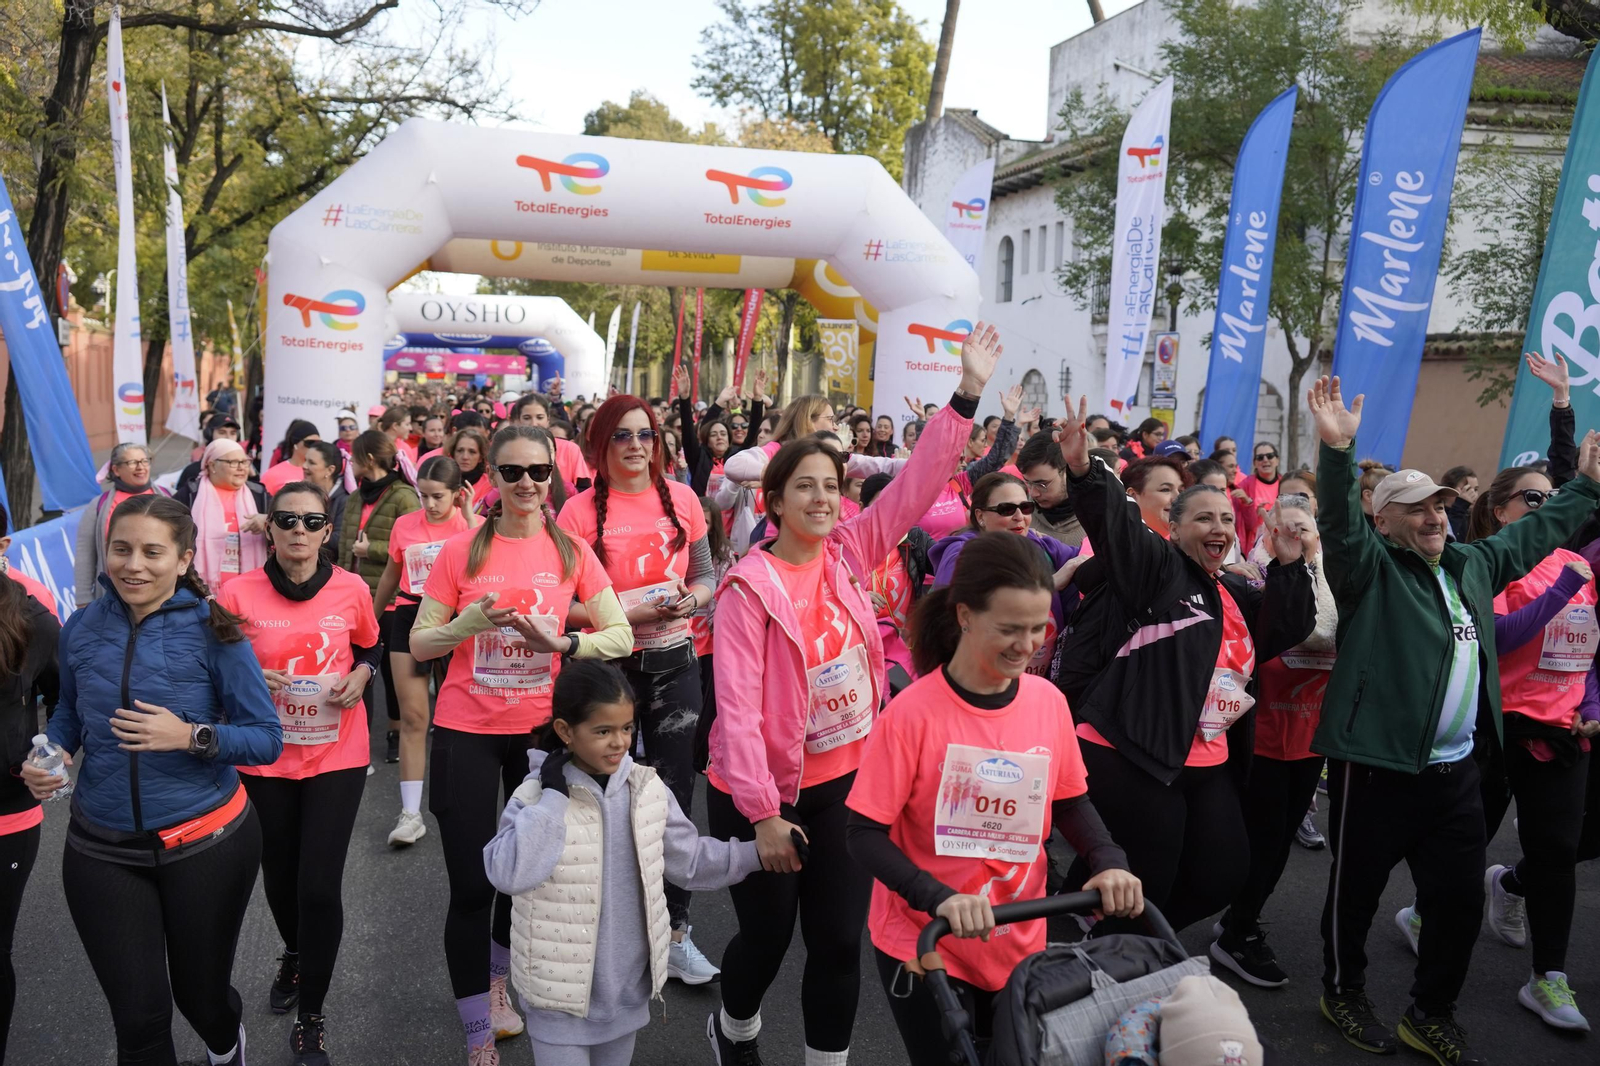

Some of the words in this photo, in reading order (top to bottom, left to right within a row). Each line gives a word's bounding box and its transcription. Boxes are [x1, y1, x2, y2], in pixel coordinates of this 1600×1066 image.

[514, 200, 609, 219] TotalEnergies
[703, 213, 792, 230] TotalEnergies
[580, 244, 627, 257] Municipal
[682, 251, 716, 259] SEVILLA
[551, 255, 564, 263] de
[567, 256, 611, 266] Deportes
[1350, 171, 1433, 347] Marlene
[1218, 210, 1269, 363] Marlene
[420, 300, 527, 325] OYSHO
[281, 335, 364, 353] TotalEnergies
[905, 361, 962, 376] TotalEnerg
[277, 395, 360, 408] totalenergieses
[254, 620, 291, 628] OYSHO
[1567, 632, 1588, 643] 016
[503, 645, 535, 658] 016
[1025, 665, 1046, 676] 016
[482, 676, 509, 685] OYSHO
[286, 683, 320, 693] ASTURIANA
[469, 684, 503, 697] CARRERA
[504, 688, 515, 697] DE
[516, 688, 526, 696] LA
[827, 688, 858, 713] 016
[1217, 699, 1241, 713] 016
[1269, 701, 1300, 712] CARRERA
[286, 703, 318, 717] 016
[840, 709, 857, 721] 2057
[816, 733, 846, 749] OYSHO
[951, 764, 973, 774] SUMA
[979, 764, 1021, 780] ASTURIANA
[975, 795, 1017, 817] 016
[981, 821, 1002, 831] 4620
[947, 827, 972, 837] CARRERA
[987, 832, 1005, 840] MUJER
[1008, 834, 1029, 842] SEVILLA
[942, 839, 977, 851] OYSHO
[997, 846, 1029, 857] Santander
[465, 1018, 487, 1030] STAY
